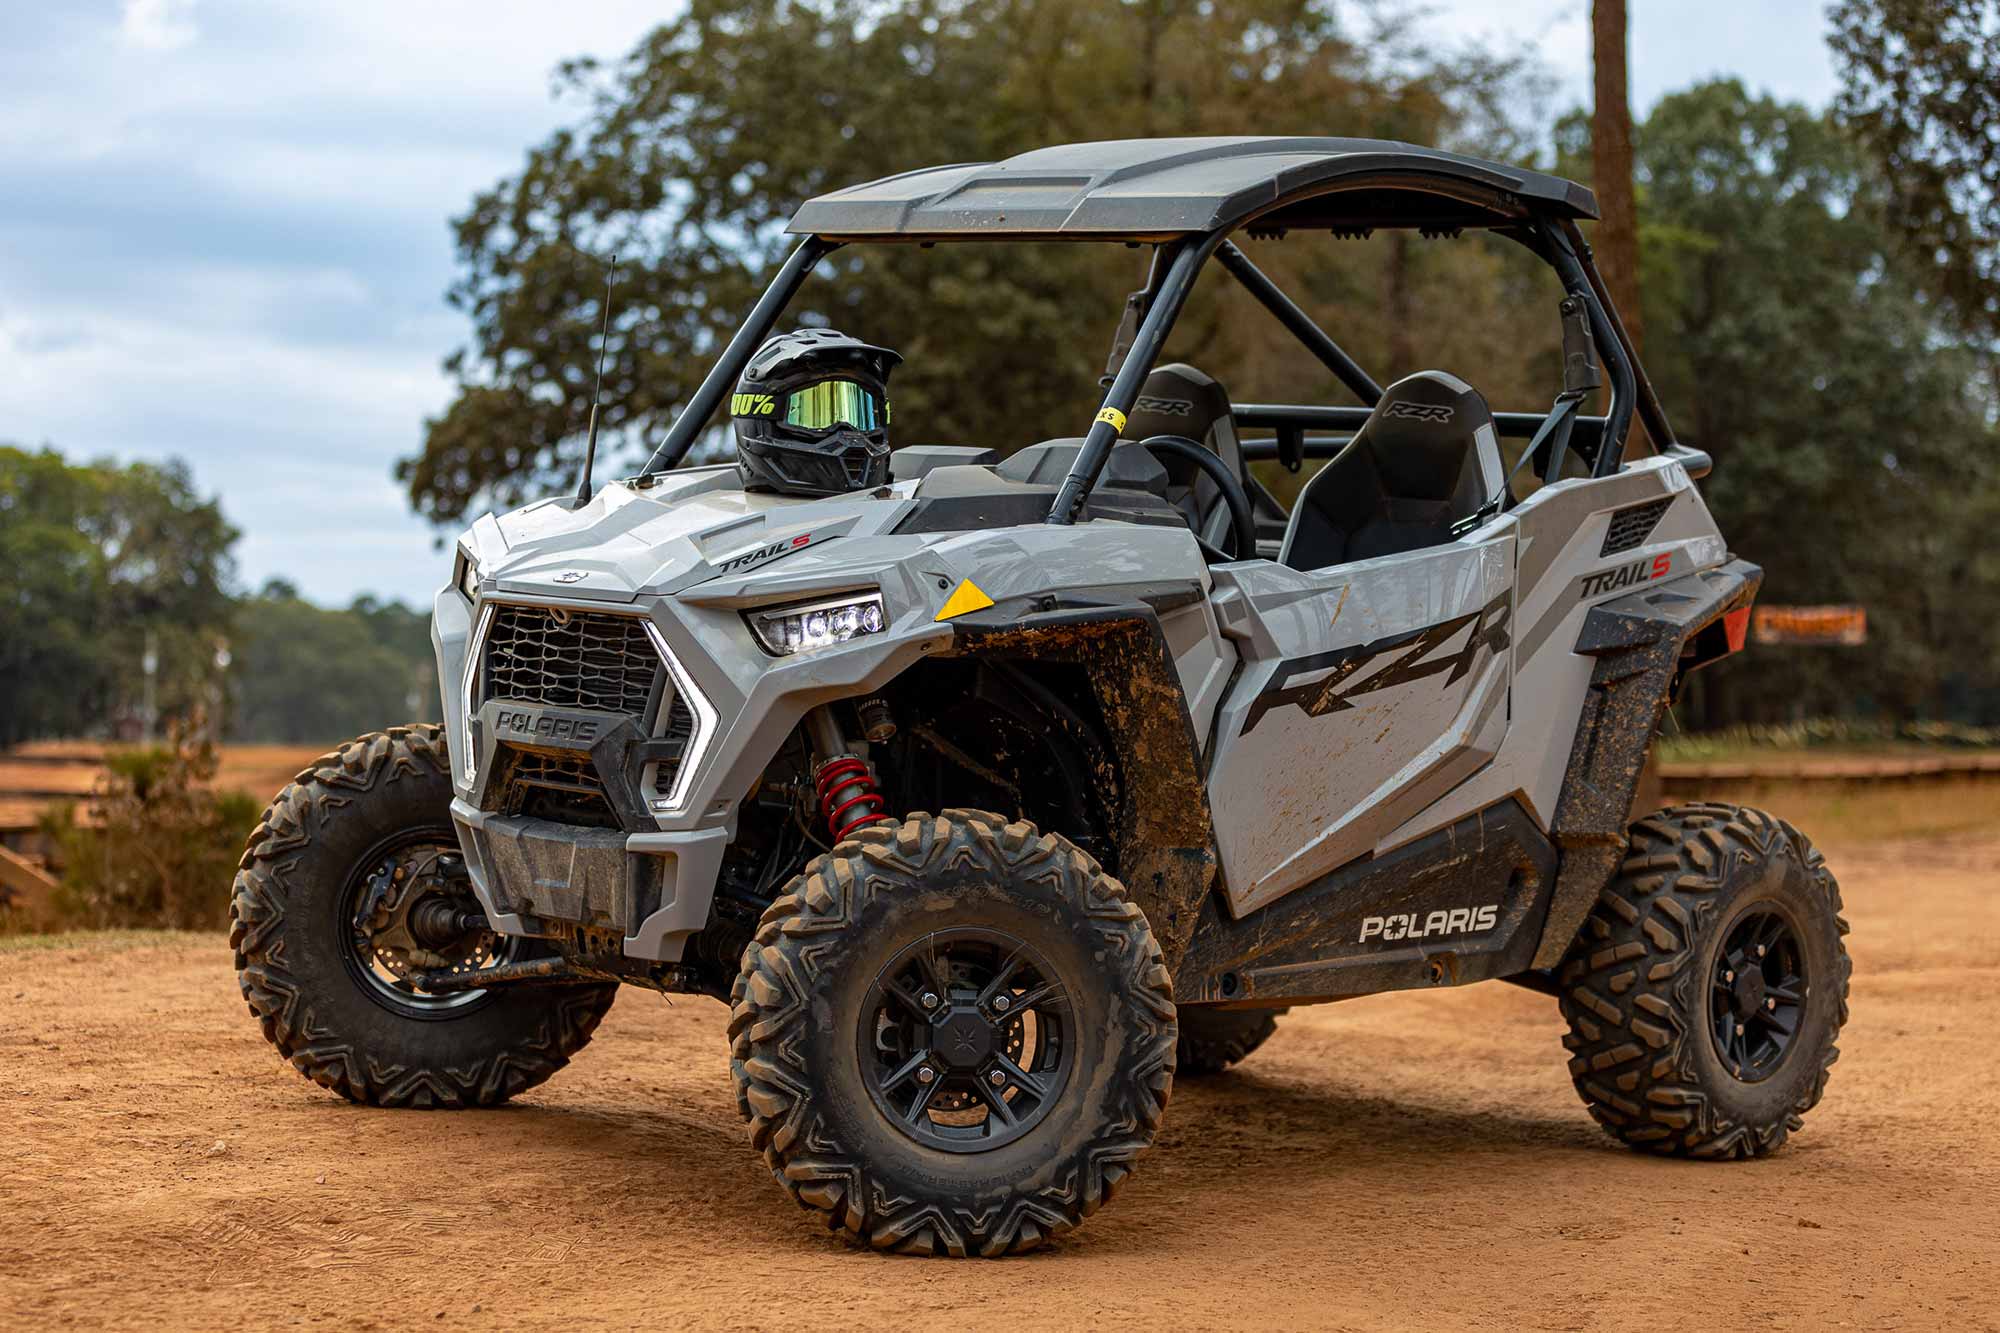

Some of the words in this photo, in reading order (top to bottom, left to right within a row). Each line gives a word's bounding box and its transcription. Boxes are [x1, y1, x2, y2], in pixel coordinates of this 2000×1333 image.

[731, 393, 775, 416] 00%
[1382, 401, 1455, 423] RZR
[719, 543, 788, 573] TRAIL
[1580, 561, 1648, 599] TRAIL
[496, 711, 600, 741] POLARIS
[1358, 904, 1498, 943] POLARIS
